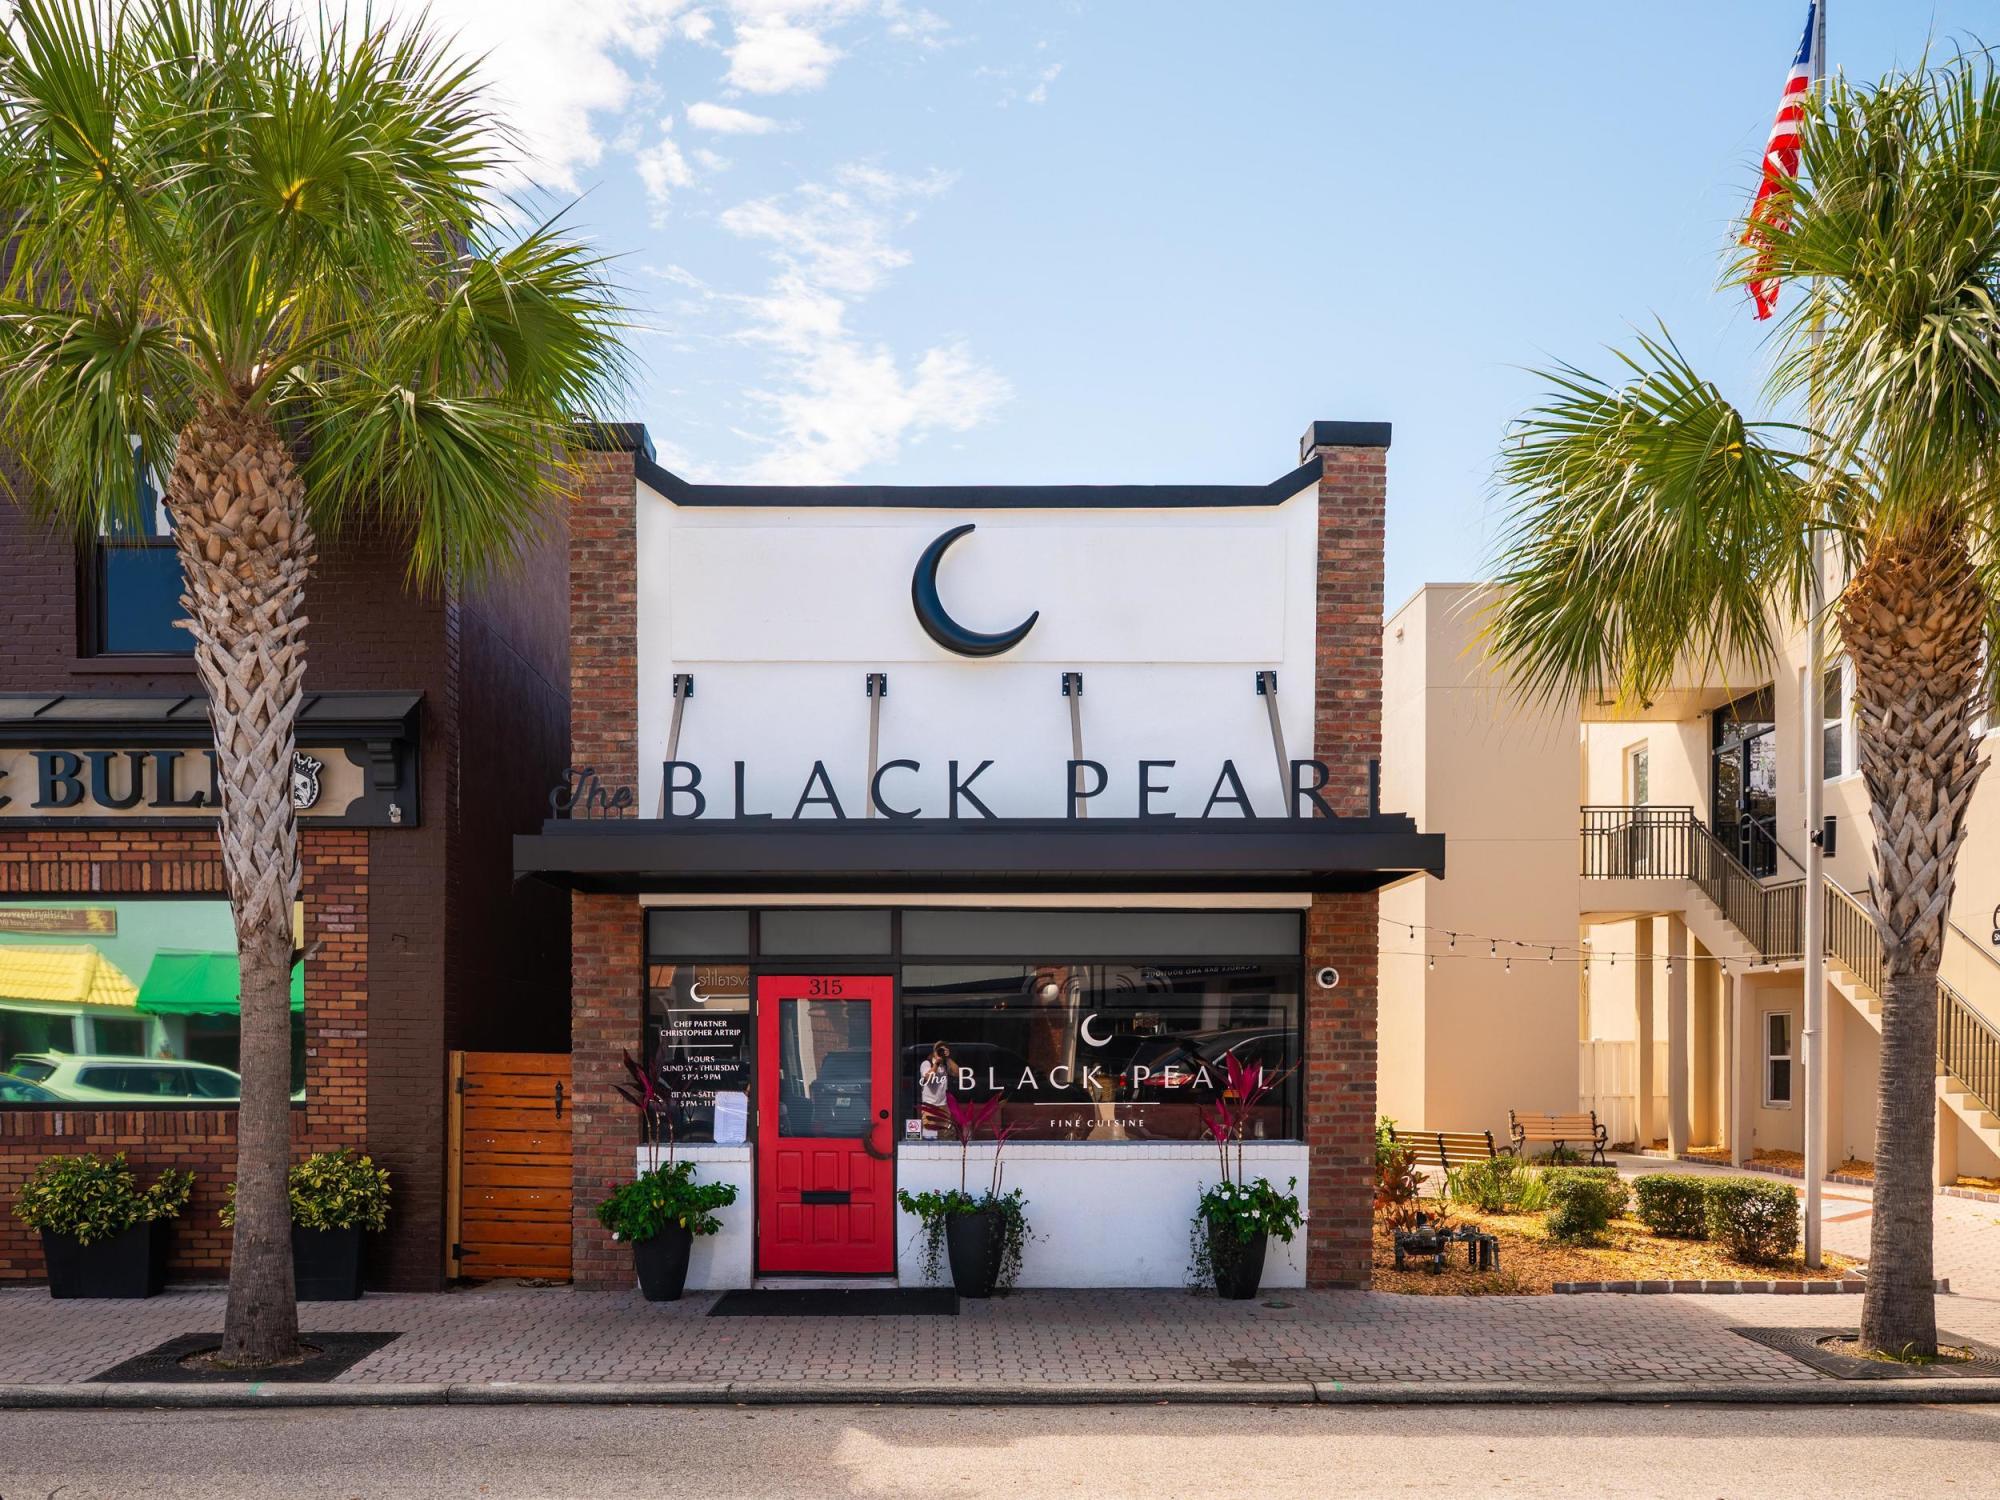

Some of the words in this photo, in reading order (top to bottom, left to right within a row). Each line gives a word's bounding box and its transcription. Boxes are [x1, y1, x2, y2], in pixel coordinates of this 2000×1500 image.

[549, 767, 633, 810] The
[662, 758, 1000, 819] BLACK
[1066, 759, 1407, 819] PEARL
[809, 978, 843, 995] 315
[673, 1020, 693, 1028] CHEF
[693, 1020, 727, 1028] PARTNER
[660, 1029, 713, 1037] CHRISTOPHER
[714, 1029, 741, 1037] ARTRIP
[919, 1071, 947, 1086] The
[958, 1065, 1103, 1091] BLACK
[1133, 1064, 1273, 1090] PEAL
[1050, 1119, 1081, 1128] FINE
[1087, 1119, 1145, 1128] CUISINE
